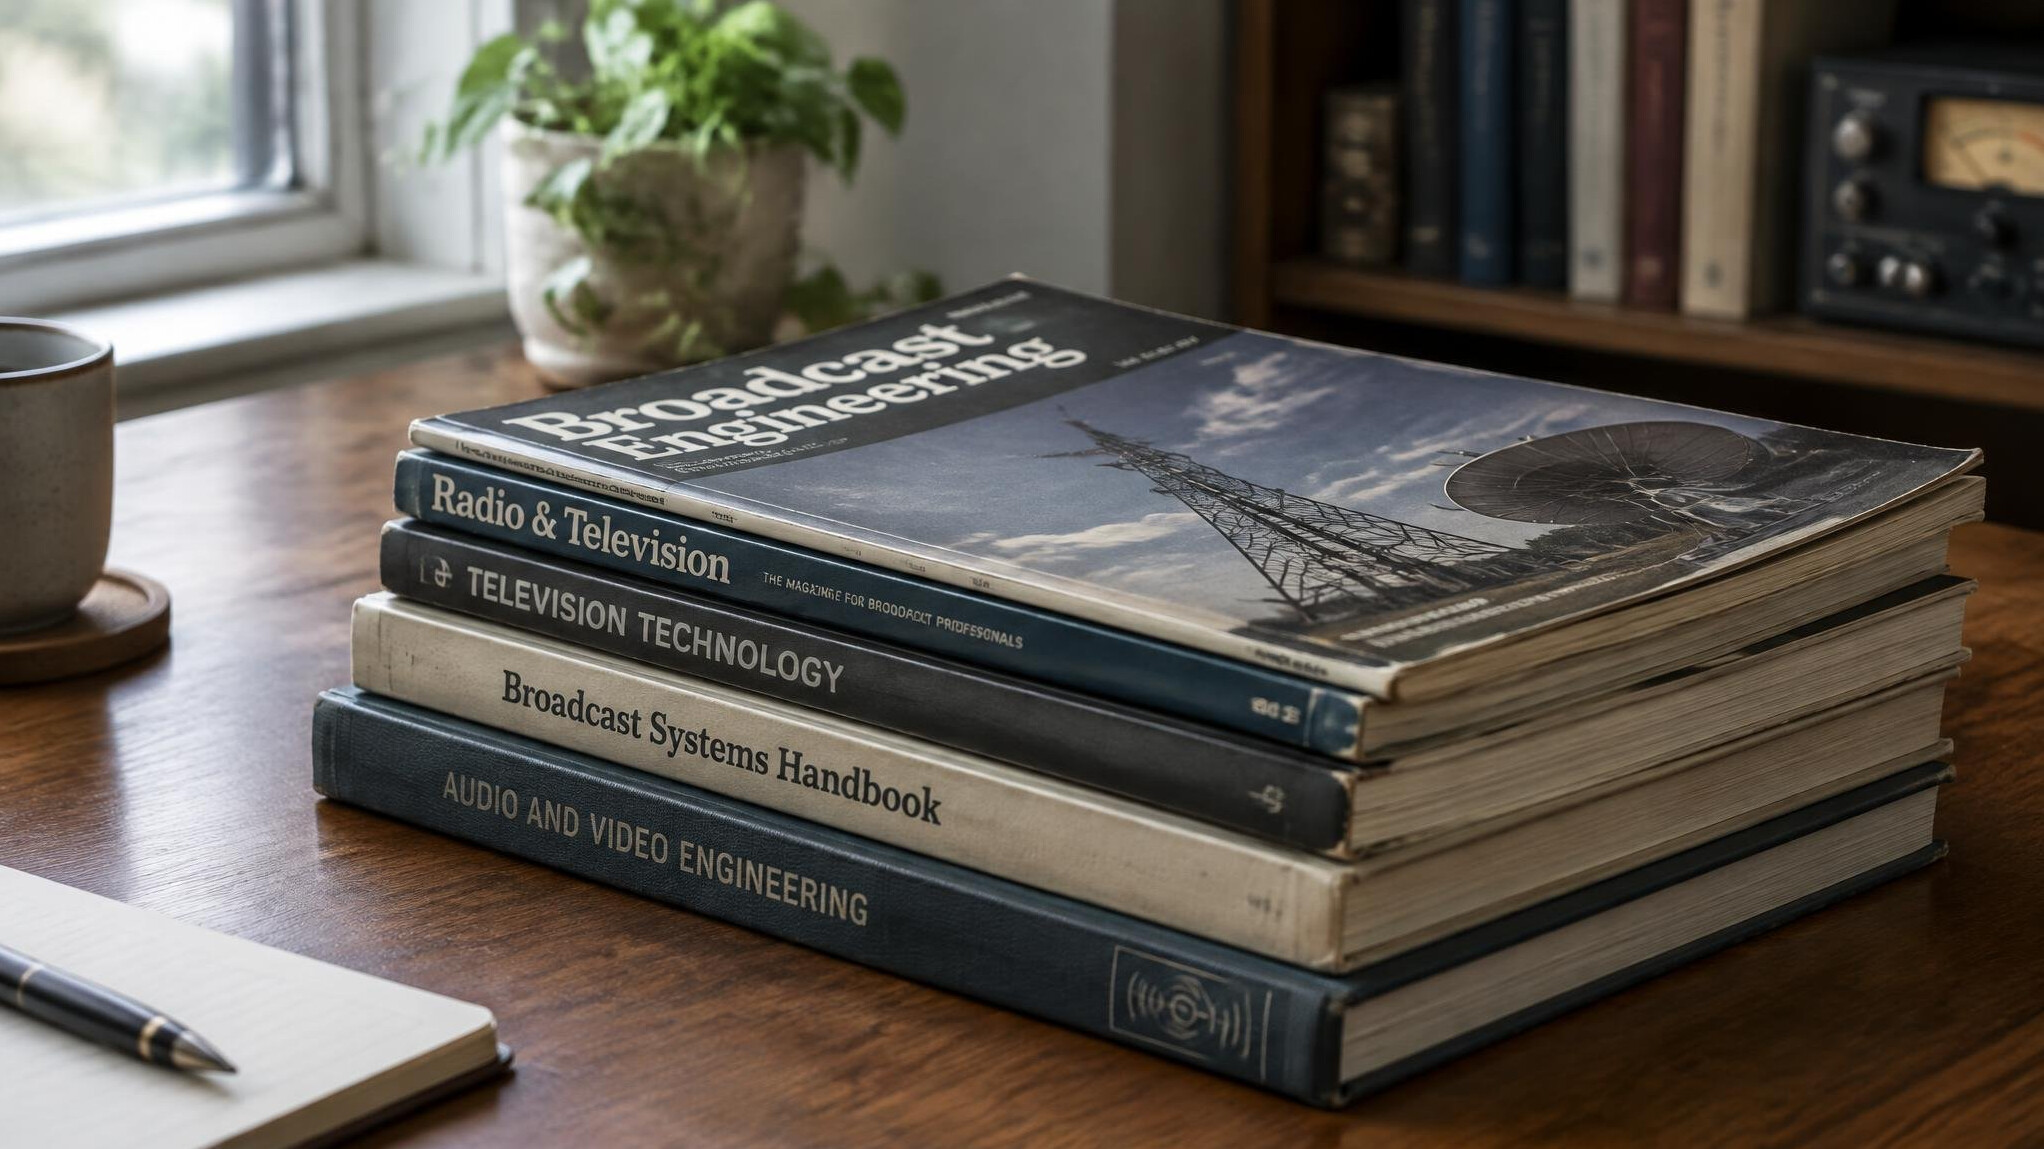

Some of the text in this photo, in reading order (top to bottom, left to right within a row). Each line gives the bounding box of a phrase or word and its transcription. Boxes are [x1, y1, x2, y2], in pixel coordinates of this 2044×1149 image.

[503, 322, 995, 443] Broadcast
[583, 337, 1087, 462] Engineering
[431, 474, 731, 584] Radio & Television
[763, 572, 783, 586] THE
[845, 592, 865, 607] FOR
[467, 566, 845, 694] TELEVISION TECHNOLOGY
[502, 670, 942, 825] Broadcast Systems Handbook
[442, 771, 869, 928] AUDIO AND VIDEO ENGINEERING
